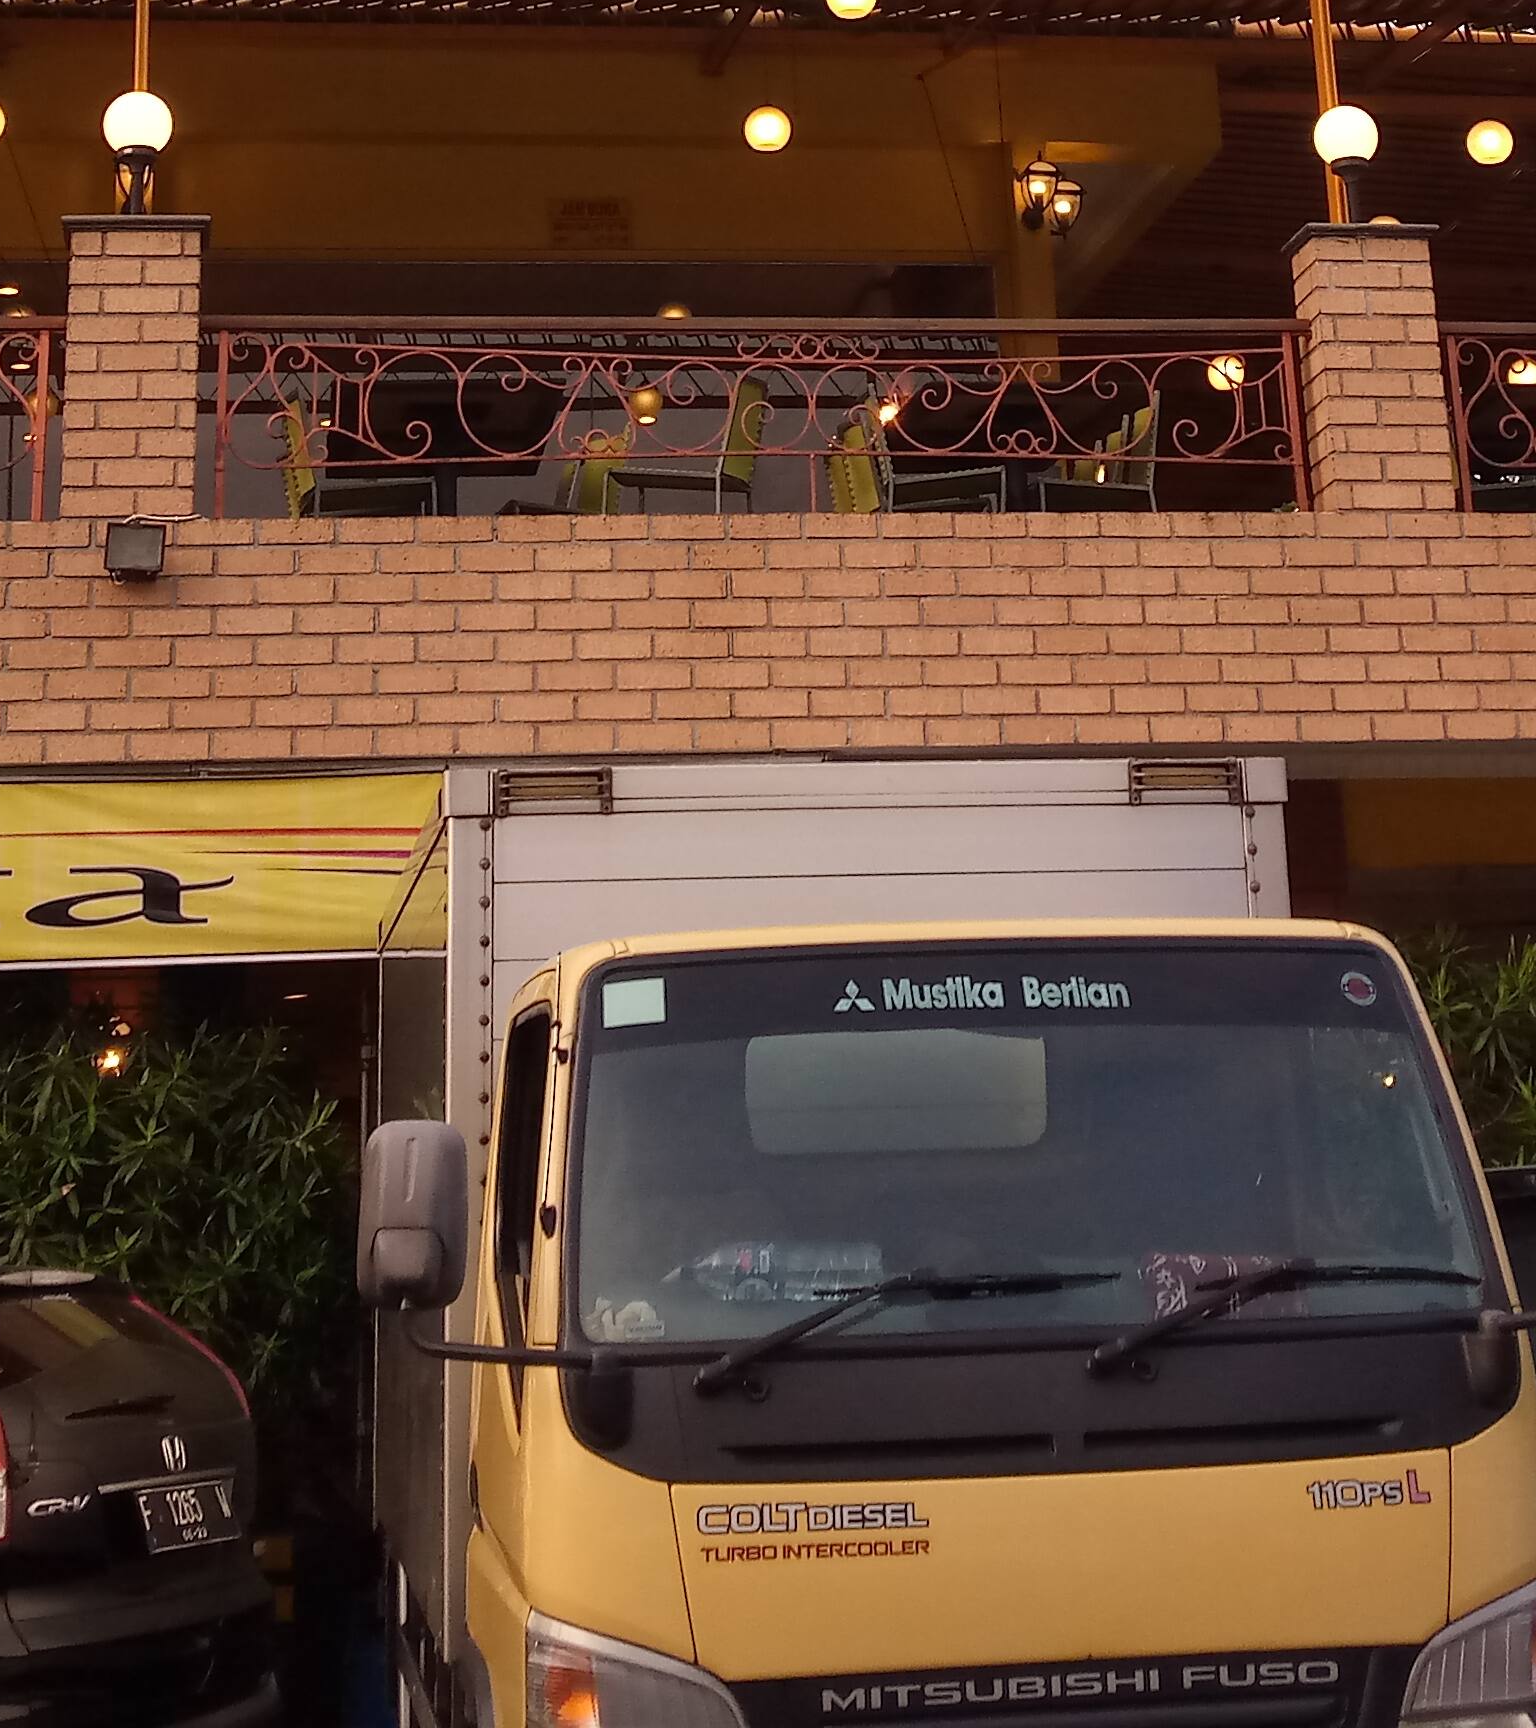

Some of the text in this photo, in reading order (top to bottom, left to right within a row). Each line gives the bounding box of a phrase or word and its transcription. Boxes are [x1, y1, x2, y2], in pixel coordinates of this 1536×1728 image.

[882, 975, 1132, 1010] Mustika Berlian
[701, 1539, 931, 1563] TURBO INTERCOOLER
[821, 1661, 1340, 1713] MITSUBISHI FUSO
